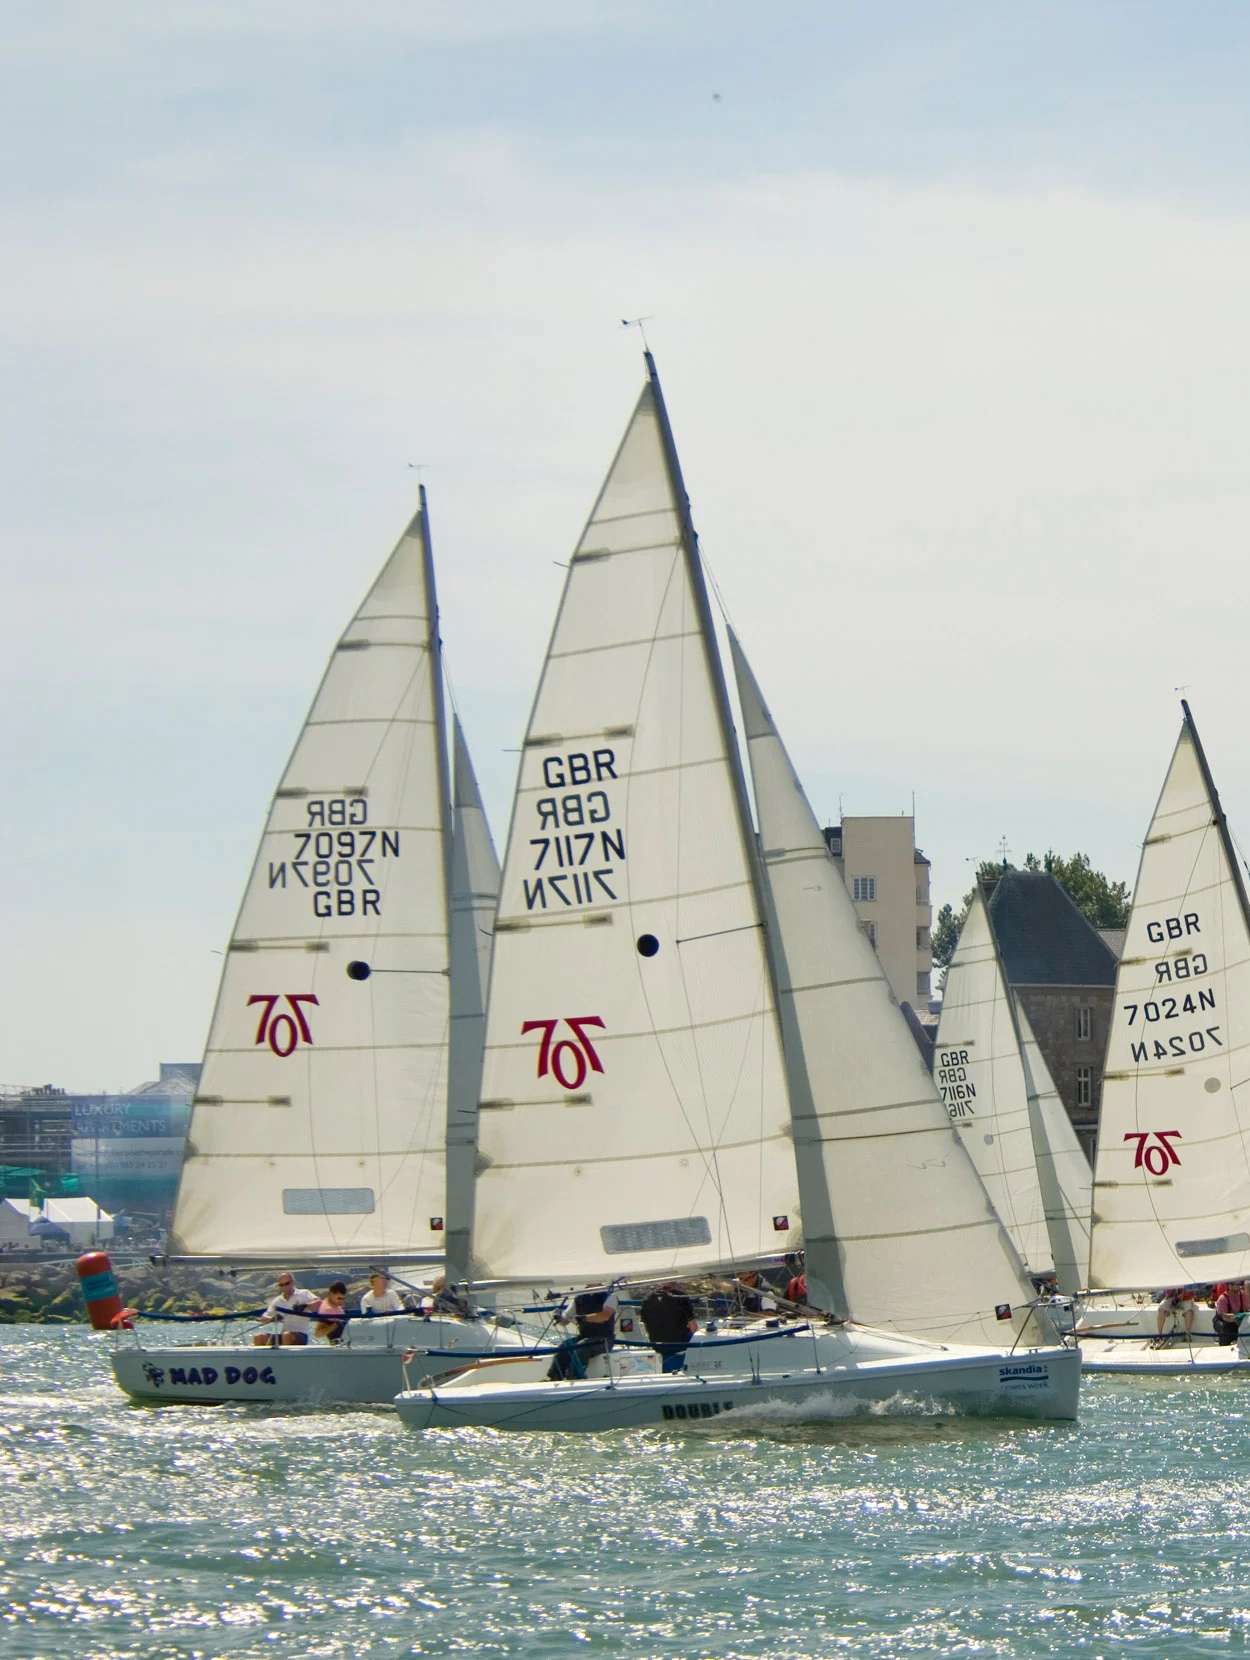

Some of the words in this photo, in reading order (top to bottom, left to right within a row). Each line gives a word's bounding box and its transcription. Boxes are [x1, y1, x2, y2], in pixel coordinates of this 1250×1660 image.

[542, 748, 618, 788] GBR
[294, 831, 400, 859] 7097N
[530, 828, 626, 870] 7117N
[313, 889, 381, 918] GBR
[1146, 912, 1201, 943] GBR
[1124, 988, 1216, 1025] 7024N
[940, 1050, 969, 1067] GBR
[940, 1083, 976, 1101] 7116N
[74, 1103, 131, 1116] LUXURY
[169, 1367, 218, 1385] MAD
[224, 1366, 277, 1385] DOG
